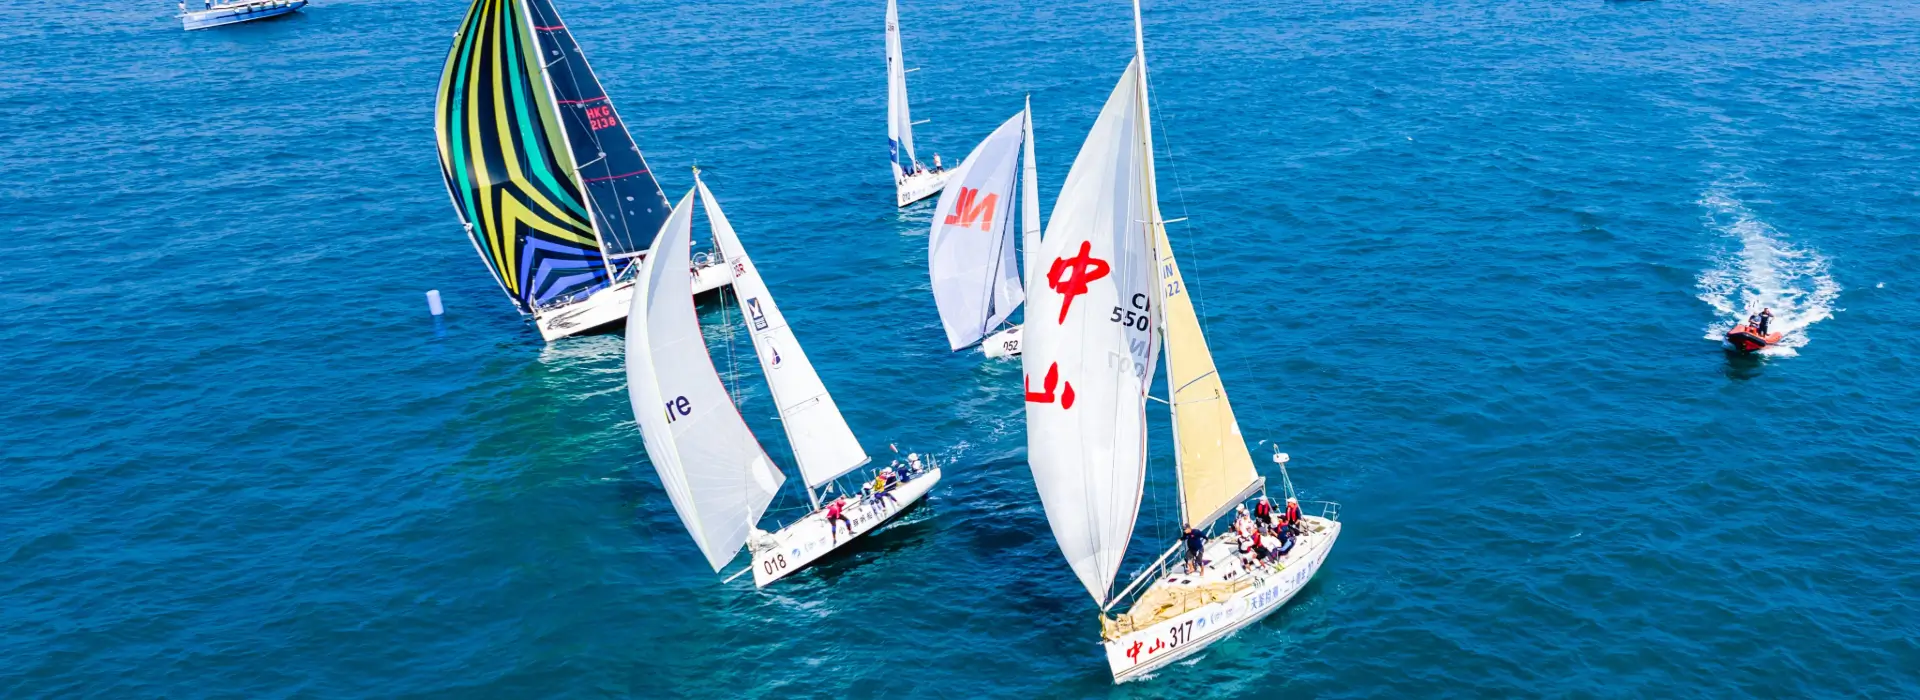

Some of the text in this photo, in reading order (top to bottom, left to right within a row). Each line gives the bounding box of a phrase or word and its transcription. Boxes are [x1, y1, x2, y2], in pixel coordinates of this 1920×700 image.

[586, 106, 609, 118] HKG
[590, 116, 616, 131] 2138
[664, 395, 691, 424] re
[763, 554, 787, 575] 018
[1126, 620, 1193, 665] 中山 317
